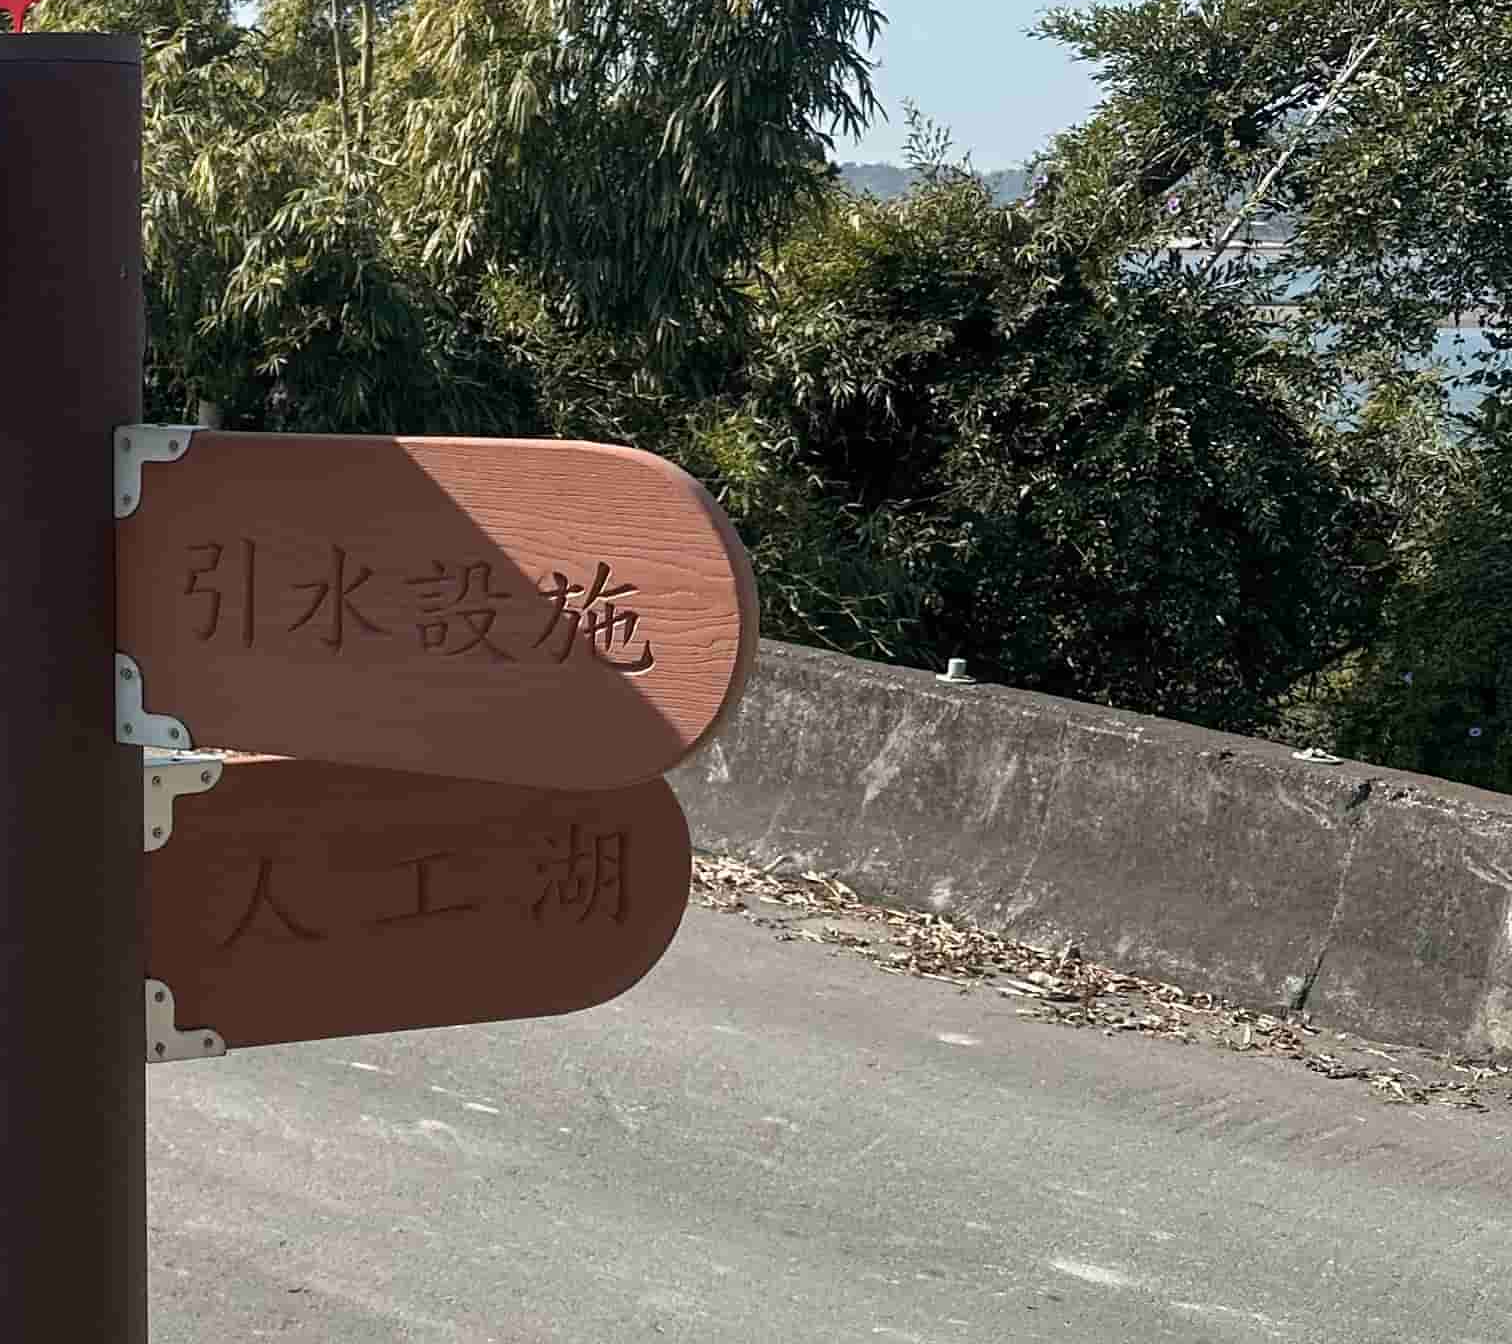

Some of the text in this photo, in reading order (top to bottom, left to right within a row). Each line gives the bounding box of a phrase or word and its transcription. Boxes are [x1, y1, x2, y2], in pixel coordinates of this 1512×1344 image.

[182, 538, 656, 676] 引水設施
[223, 824, 630, 950] 人工湖
